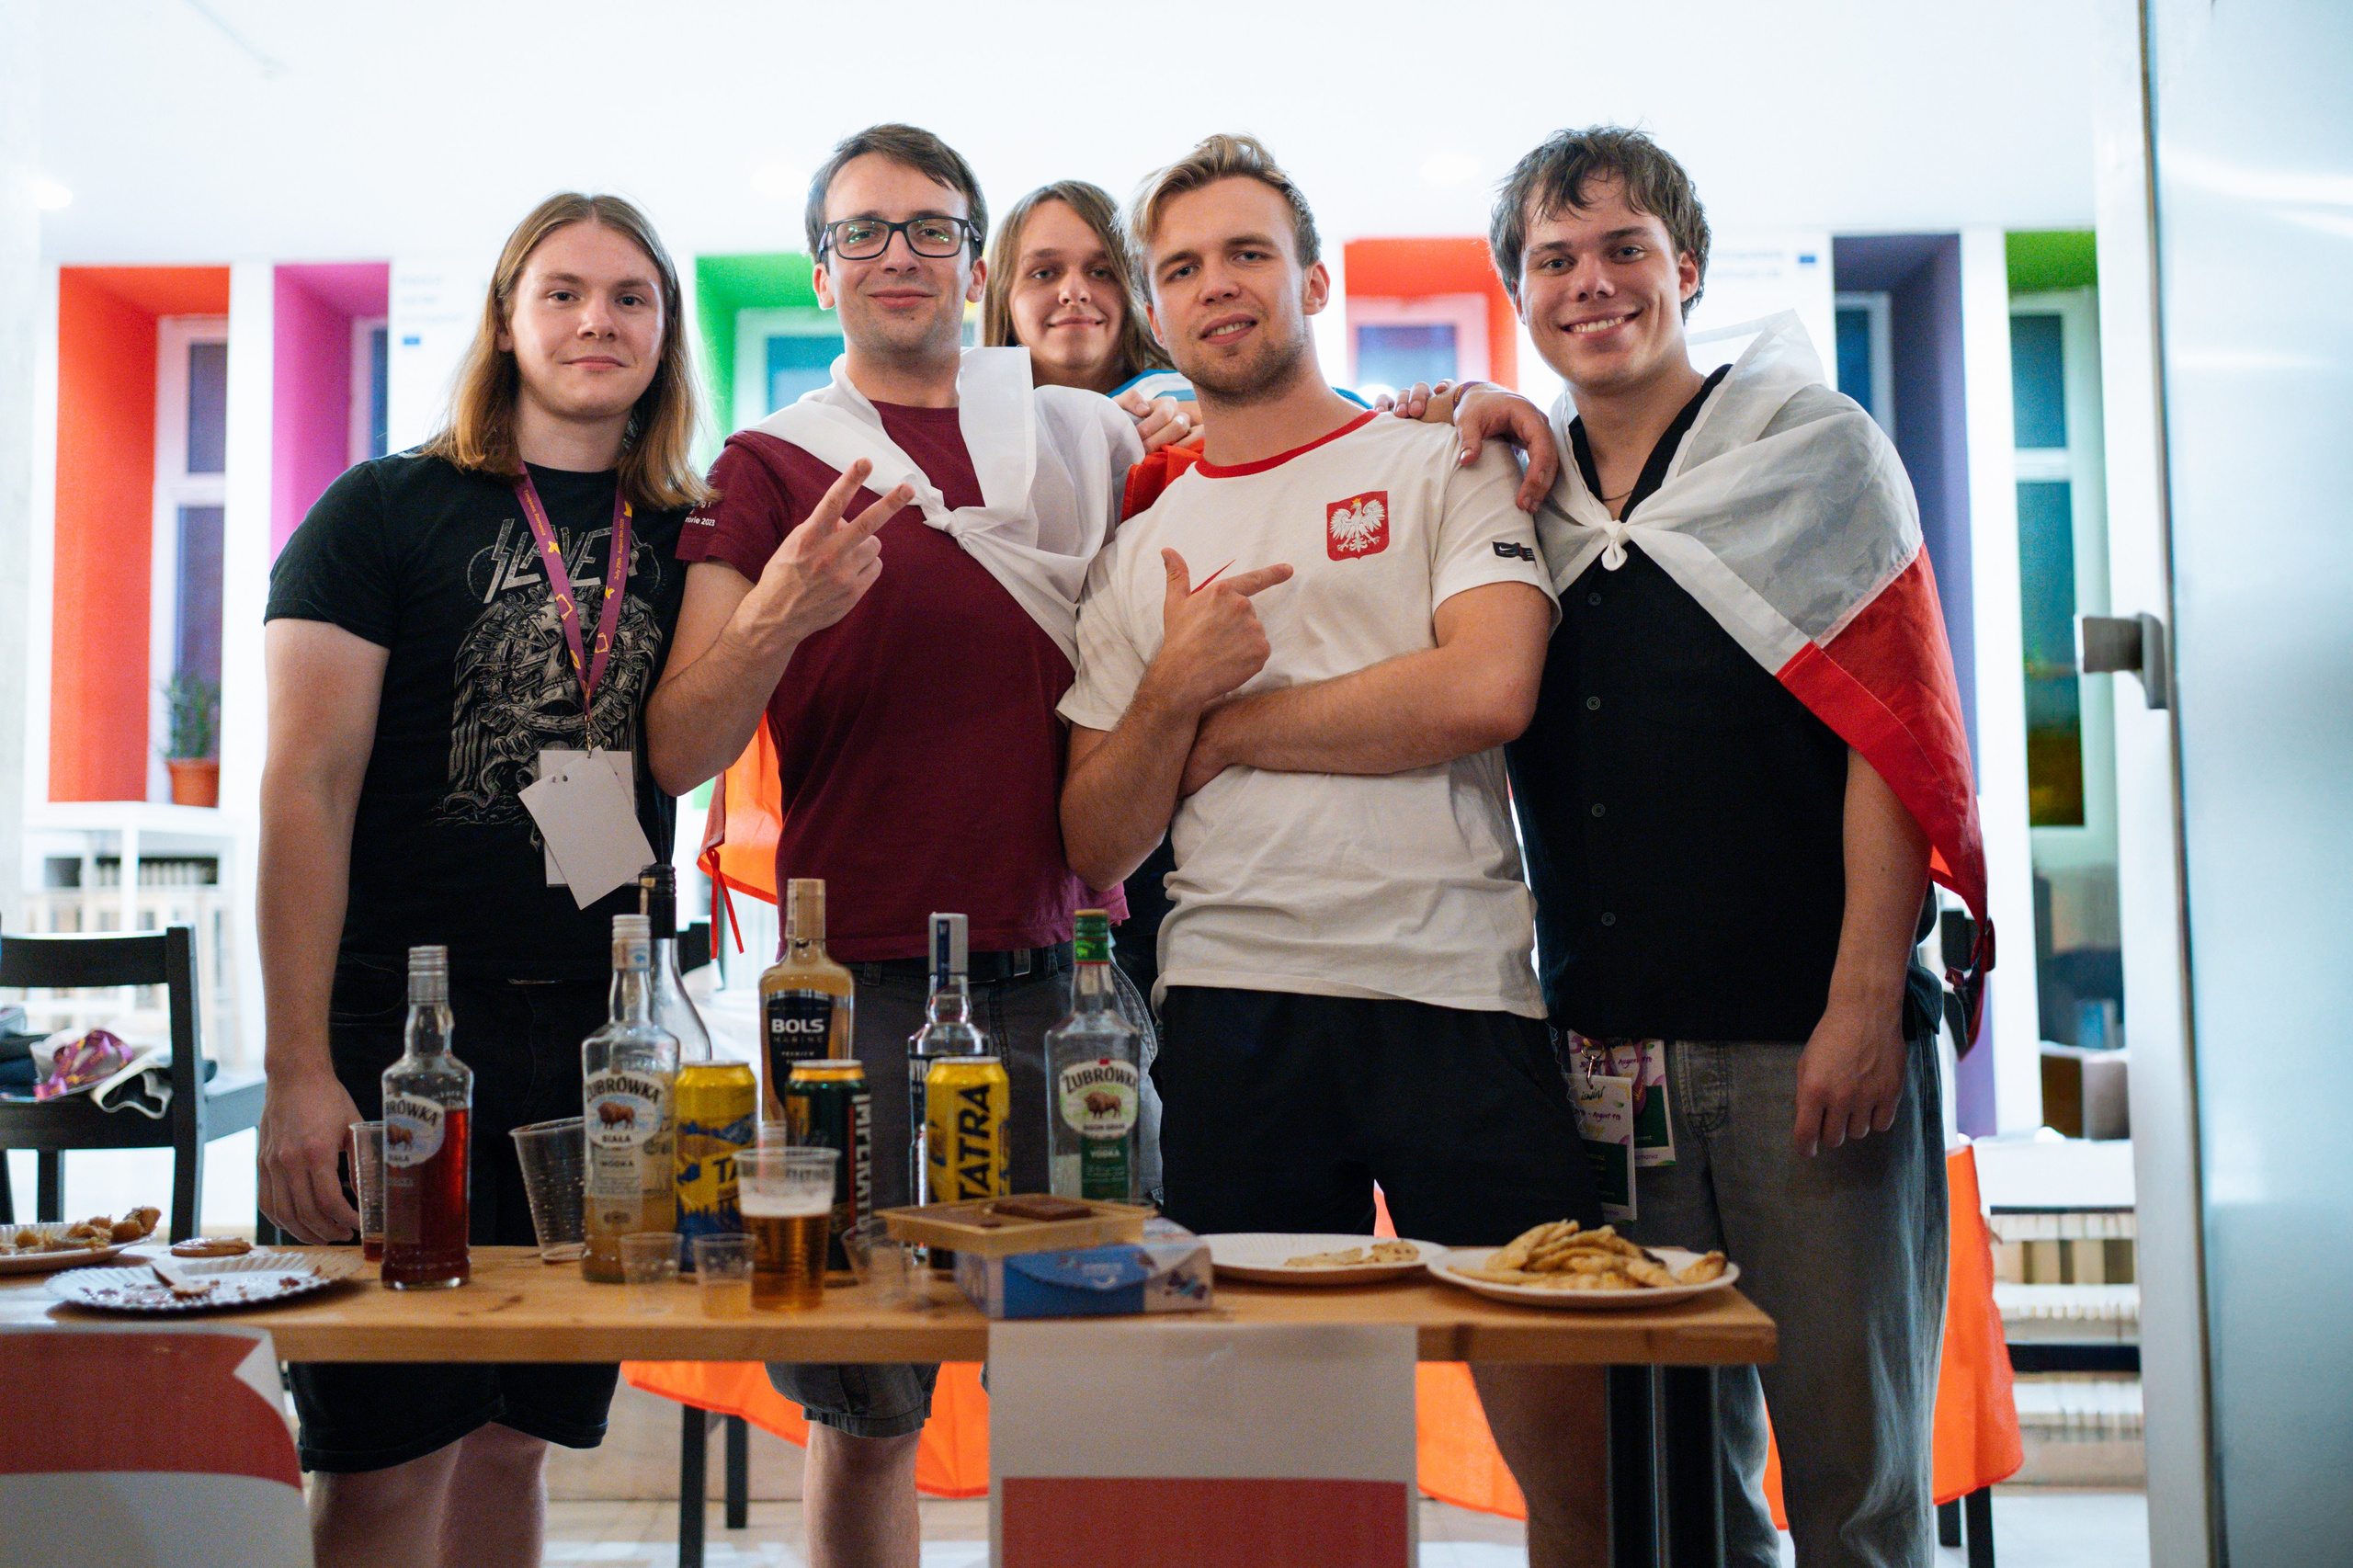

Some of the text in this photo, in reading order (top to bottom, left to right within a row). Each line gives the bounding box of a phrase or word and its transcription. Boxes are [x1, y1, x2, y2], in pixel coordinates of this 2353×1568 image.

[700, 517, 716, 527] 2023
[483, 517, 639, 603] SLAYE
[771, 1018, 825, 1034] BOLS
